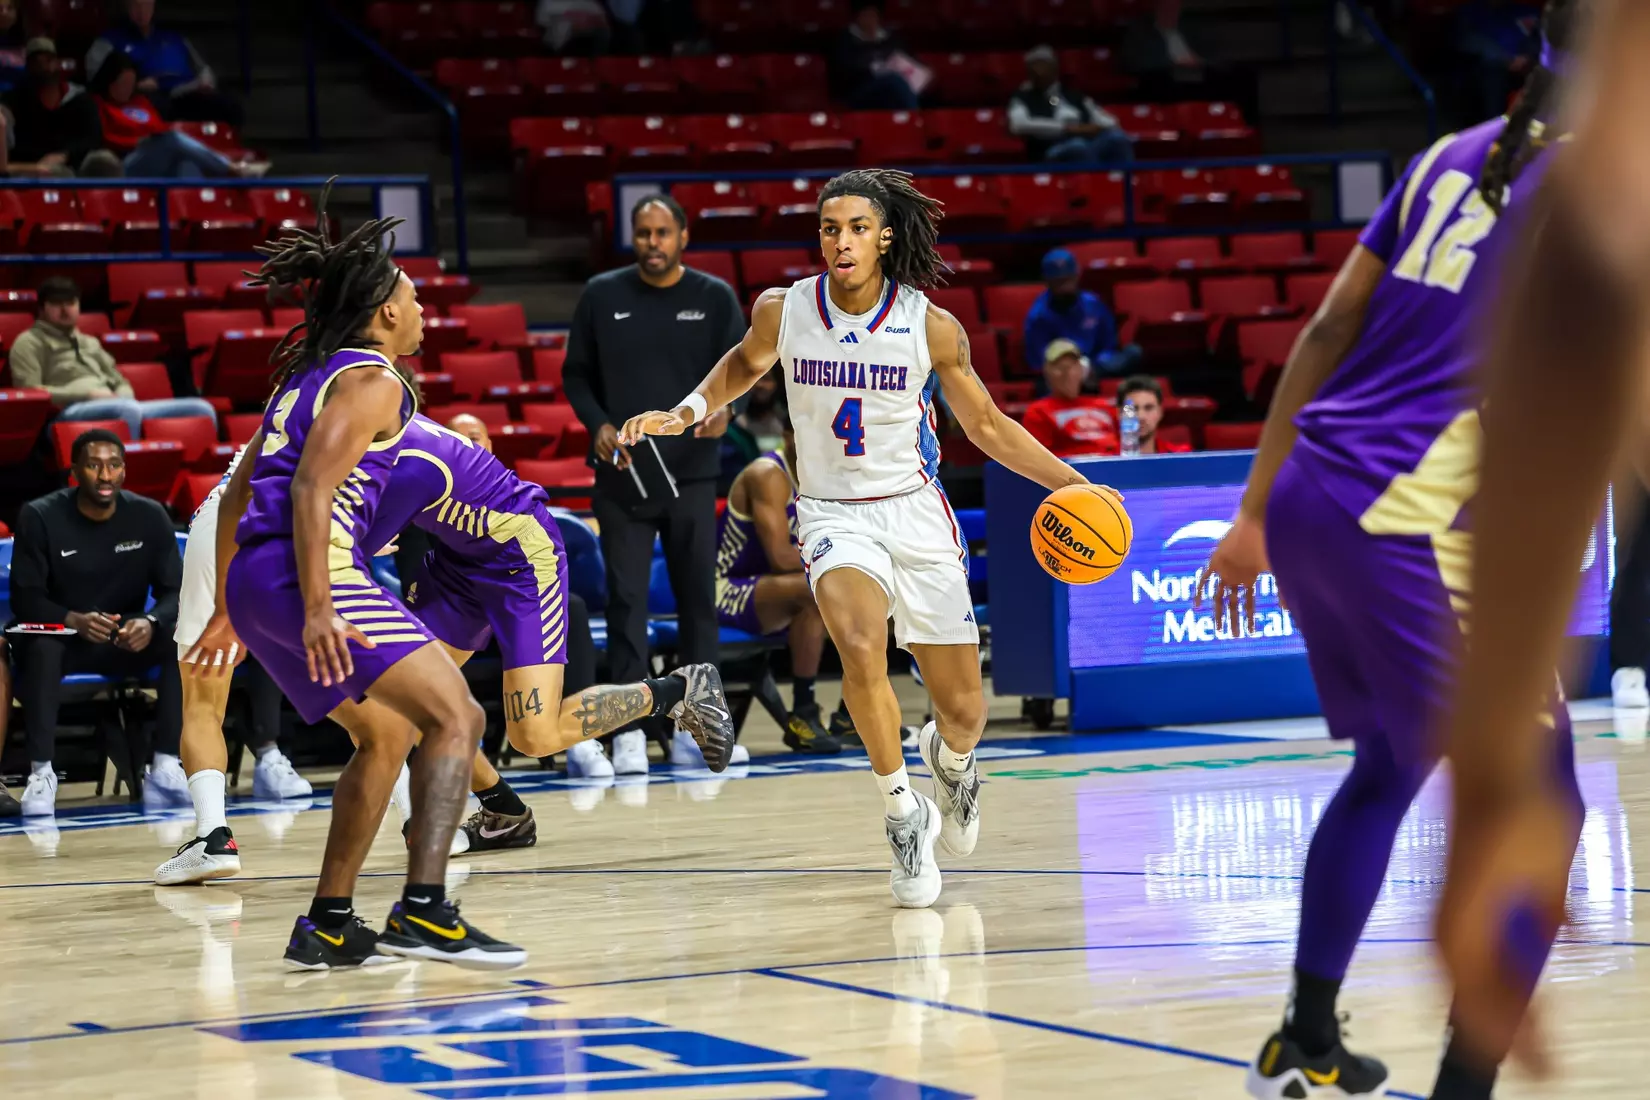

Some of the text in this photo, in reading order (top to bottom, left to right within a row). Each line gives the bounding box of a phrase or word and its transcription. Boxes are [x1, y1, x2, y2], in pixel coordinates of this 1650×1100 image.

[1391, 168, 1510, 294] 12
[793, 358, 908, 391] LOUISIANA TECH
[261, 388, 300, 457] 3
[831, 397, 866, 457] 4
[1041, 510, 1096, 561] Wilson
[1131, 568, 1279, 604] Northrn
[1163, 606, 1293, 643] Medical
